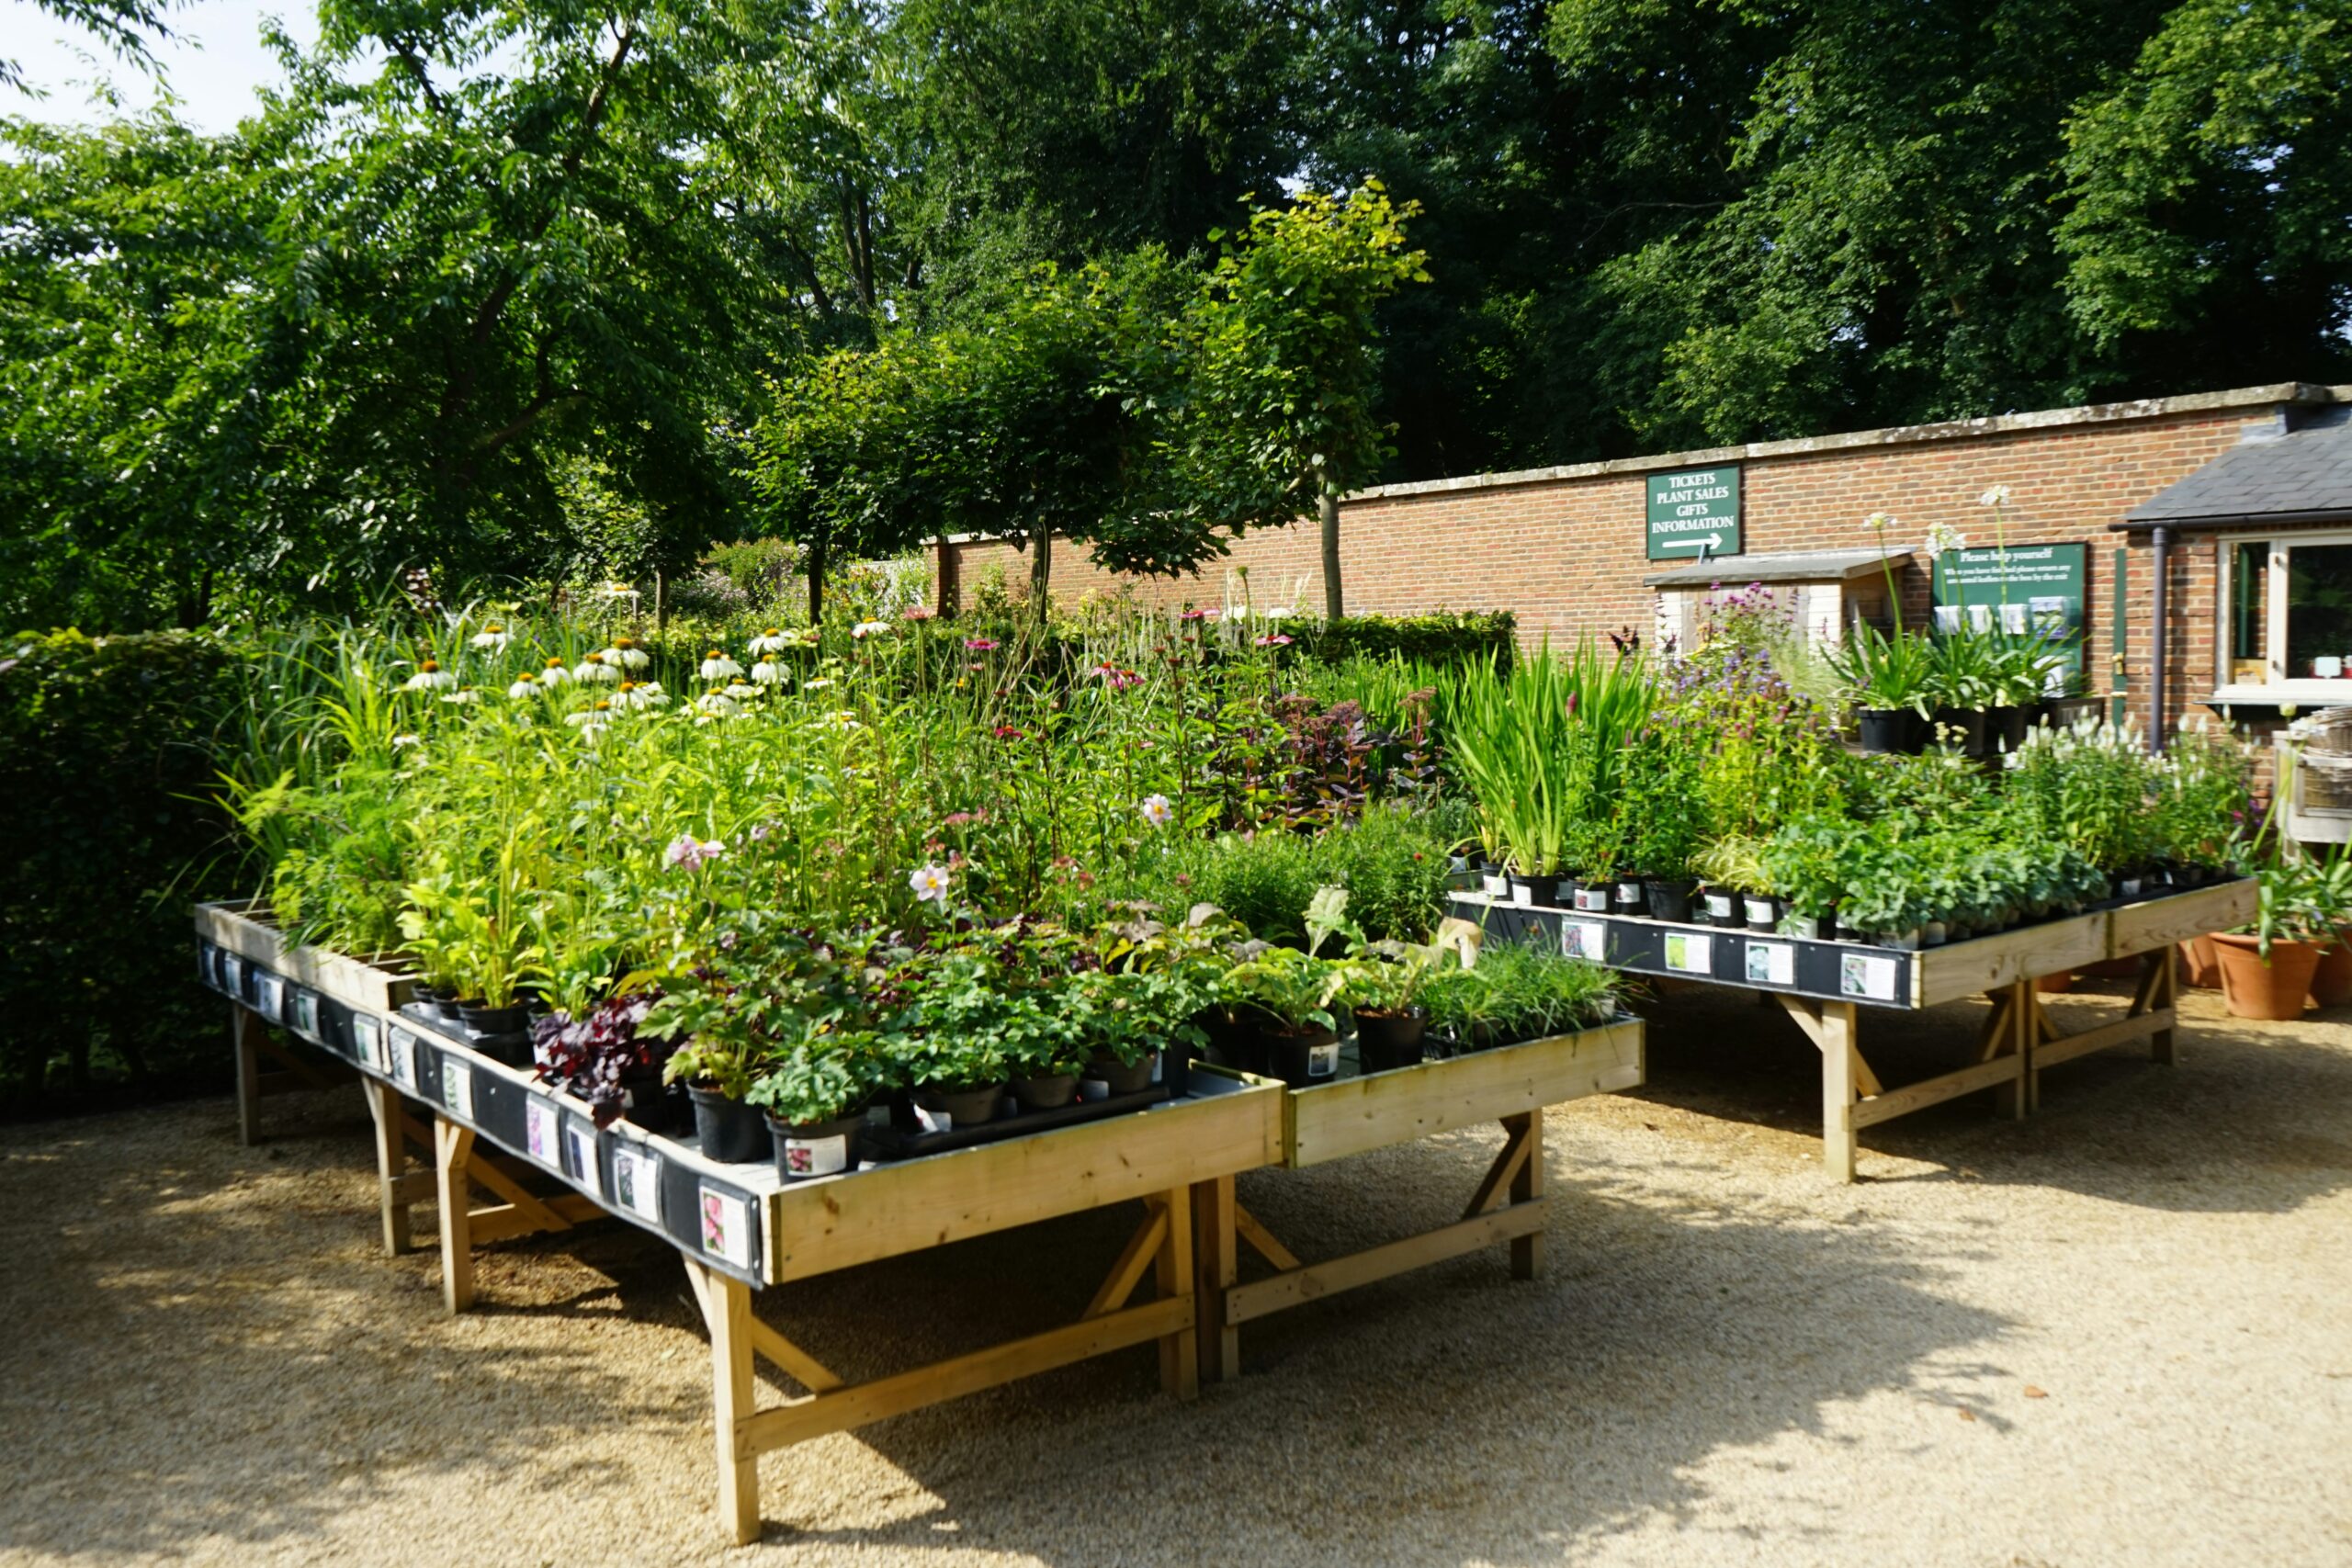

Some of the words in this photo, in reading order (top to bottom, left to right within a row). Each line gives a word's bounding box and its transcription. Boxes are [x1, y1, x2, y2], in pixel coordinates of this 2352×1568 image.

[1668, 473, 1715, 489] TICKETS
[1657, 489, 1694, 504] PLANT
[1694, 486, 1729, 501] SALES
[1676, 502, 1709, 517] GIFTS
[1652, 515, 1735, 534] INFORMATION
[1960, 552, 1989, 562] Please
[1990, 550, 2011, 562] hep
[2012, 547, 2053, 562] yourself
[1944, 568, 1962, 576] Whn
[1990, 566, 2017, 574] finihed
